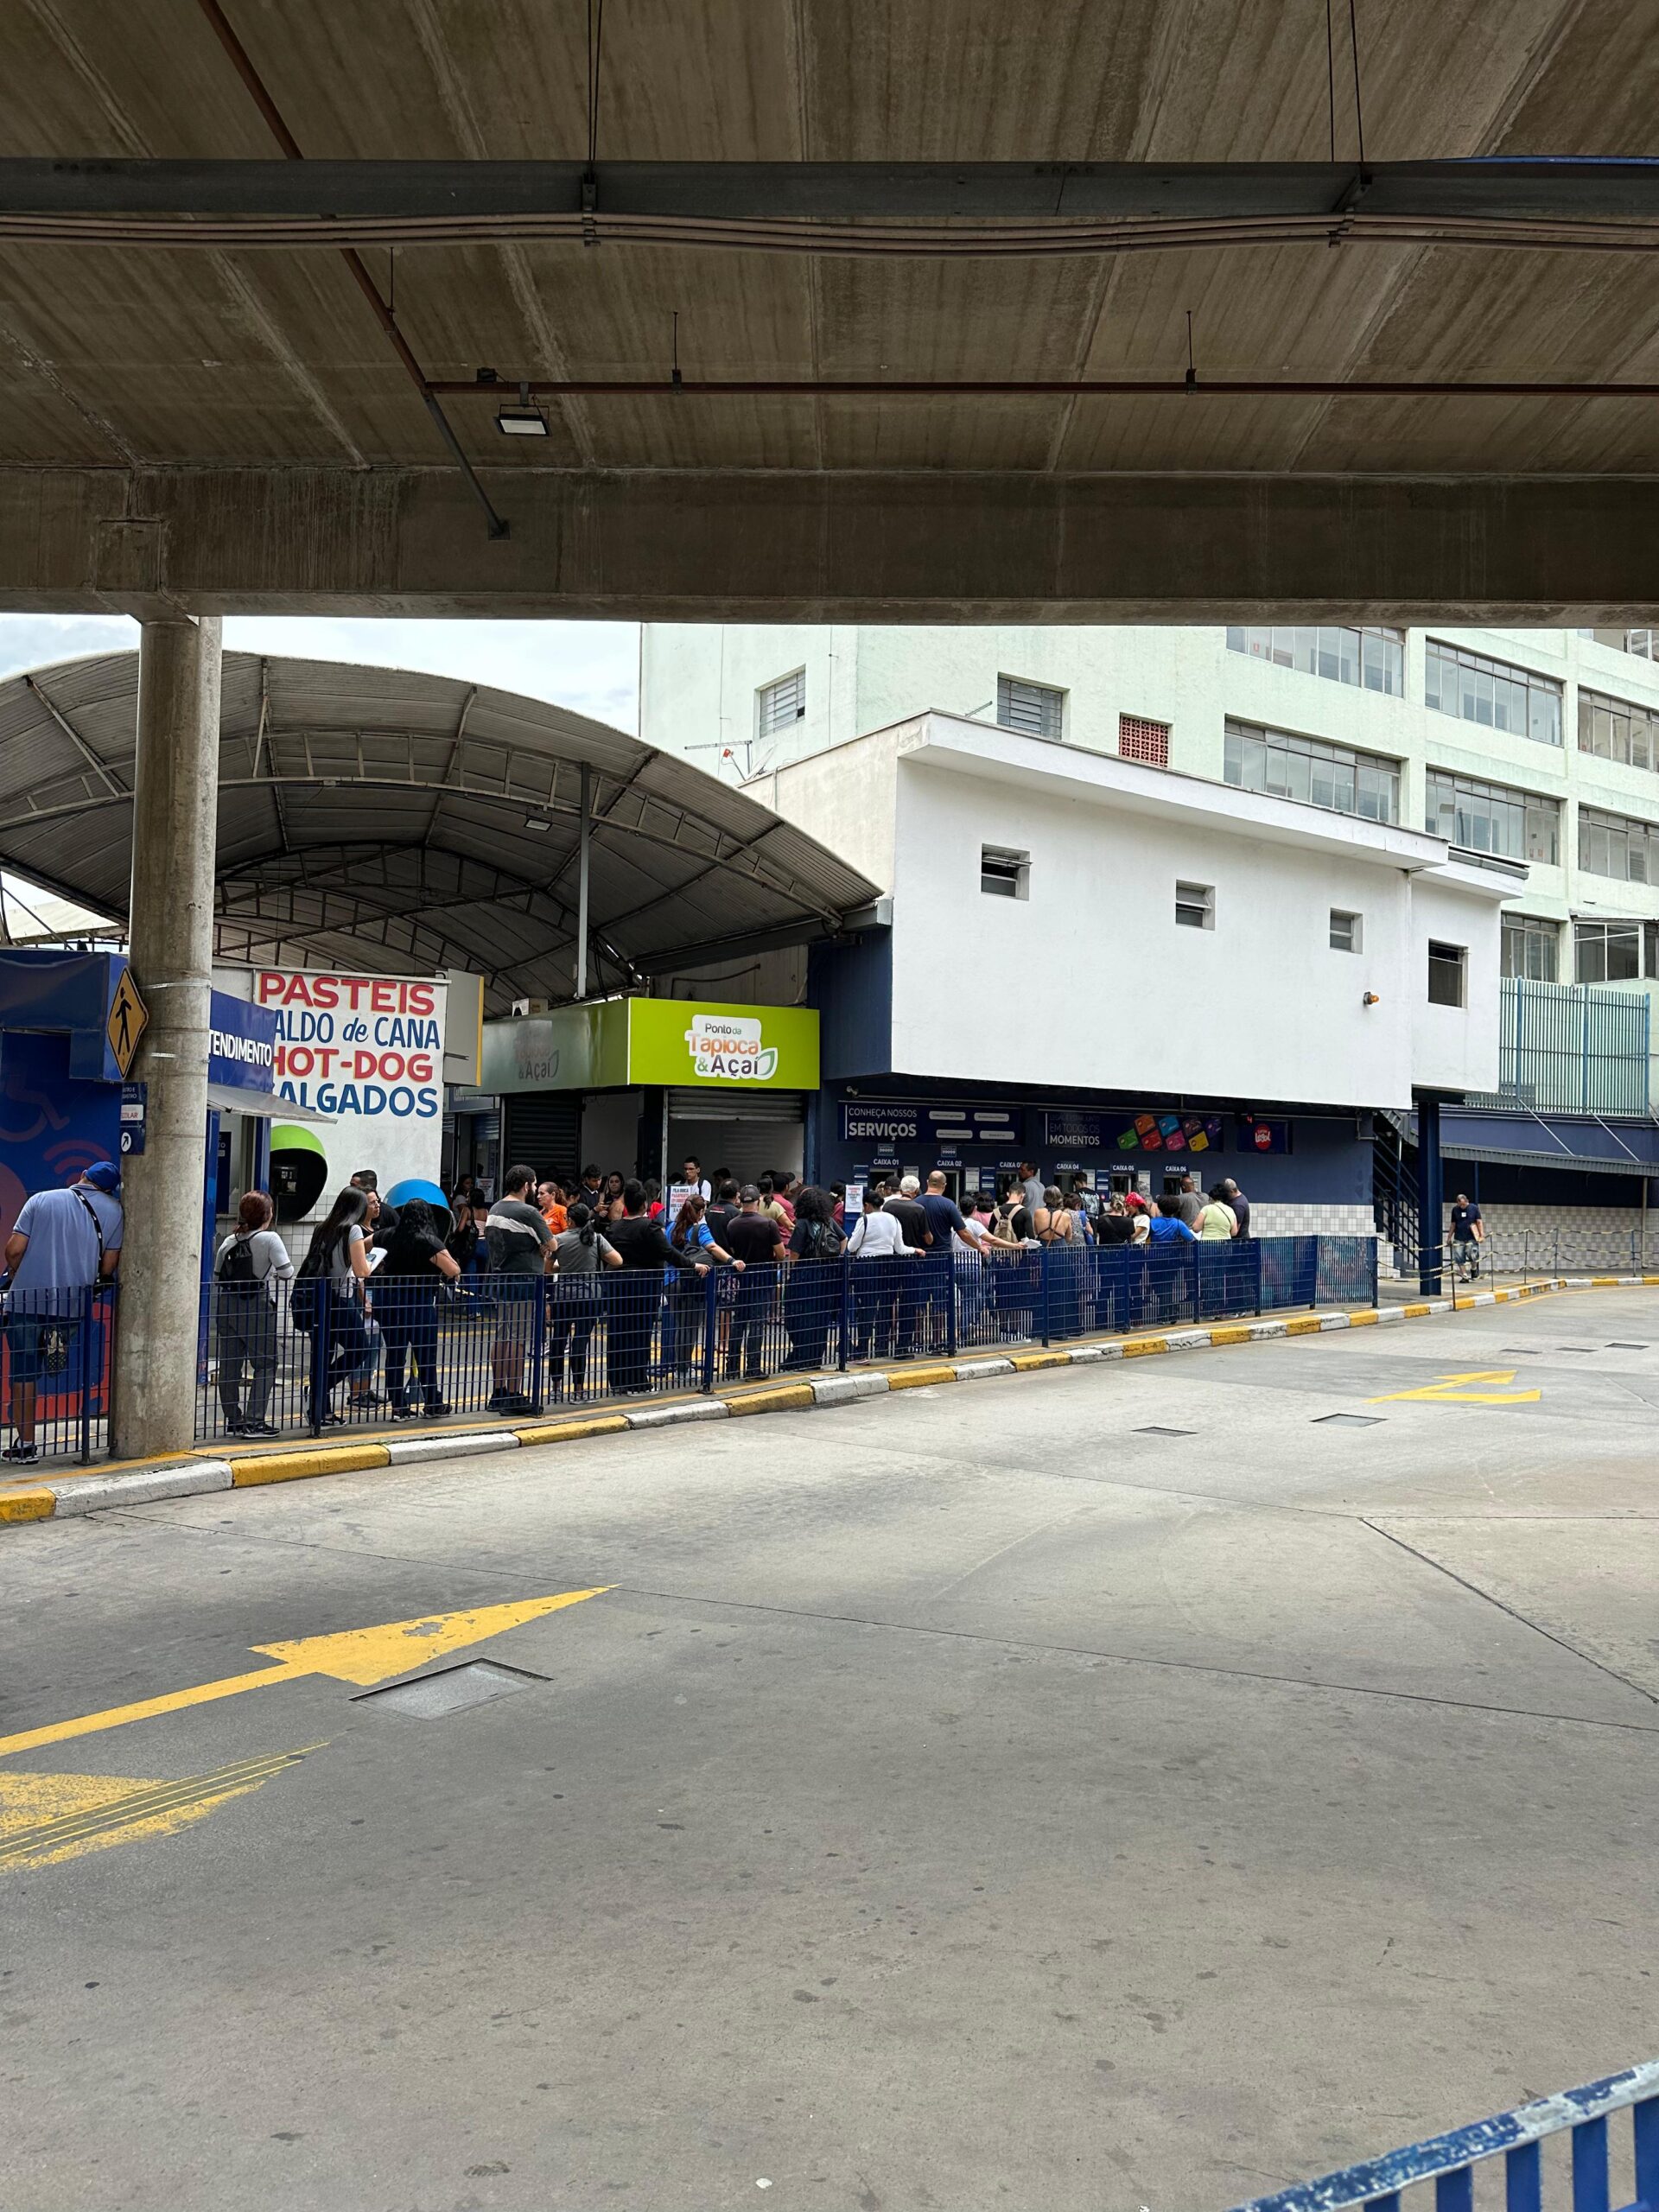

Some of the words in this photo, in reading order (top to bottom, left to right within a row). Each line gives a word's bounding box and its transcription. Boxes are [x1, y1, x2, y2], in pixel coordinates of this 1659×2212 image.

[260, 973, 435, 1016] PASTEIS
[275, 1009, 334, 1043] ALDO
[342, 1017, 369, 1042] de
[374, 1017, 440, 1049] CANA
[705, 1023, 732, 1034] Ponto
[208, 1028, 272, 1067] TENDIMENTO
[688, 1033, 759, 1058] Tapioca
[273, 1046, 434, 1083] HOT-DOG
[697, 1057, 709, 1072] &
[710, 1054, 760, 1077] Açaí
[273, 1081, 438, 1118] ALGADOS
[849, 1108, 887, 1118] CONHEÇA
[887, 1109, 918, 1118] NOSSOS
[849, 1122, 918, 1141] SERVIÇOS
[1050, 1122, 1062, 1133] EM
[1062, 1123, 1088, 1134] TODOS
[1089, 1124, 1100, 1134] OS
[1050, 1135, 1100, 1146] MOMENTOS
